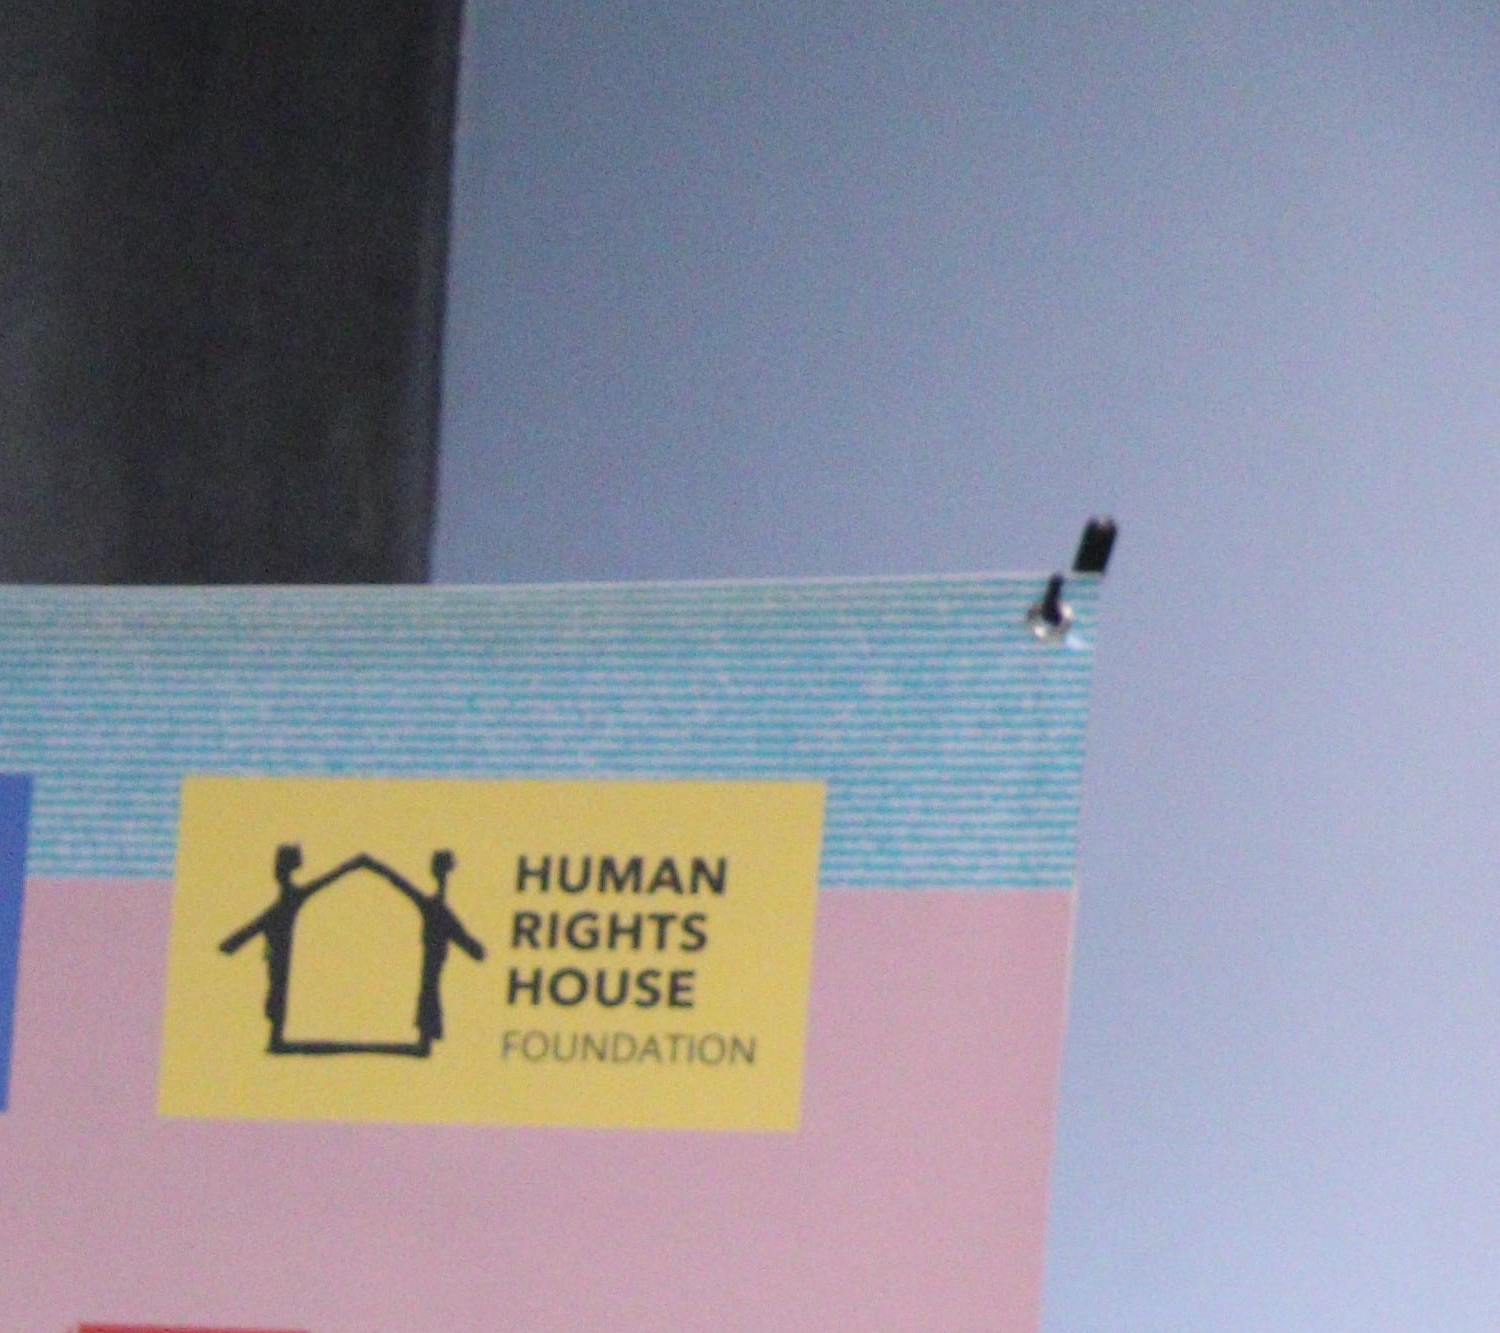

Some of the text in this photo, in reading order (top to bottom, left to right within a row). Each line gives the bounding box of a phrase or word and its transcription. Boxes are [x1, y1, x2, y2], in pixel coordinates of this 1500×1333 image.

[514, 854, 728, 895] HUMAN
[510, 911, 709, 951] RIGHTS
[505, 966, 697, 1009] HOUSE
[501, 1029, 757, 1065] FOUNDATION
